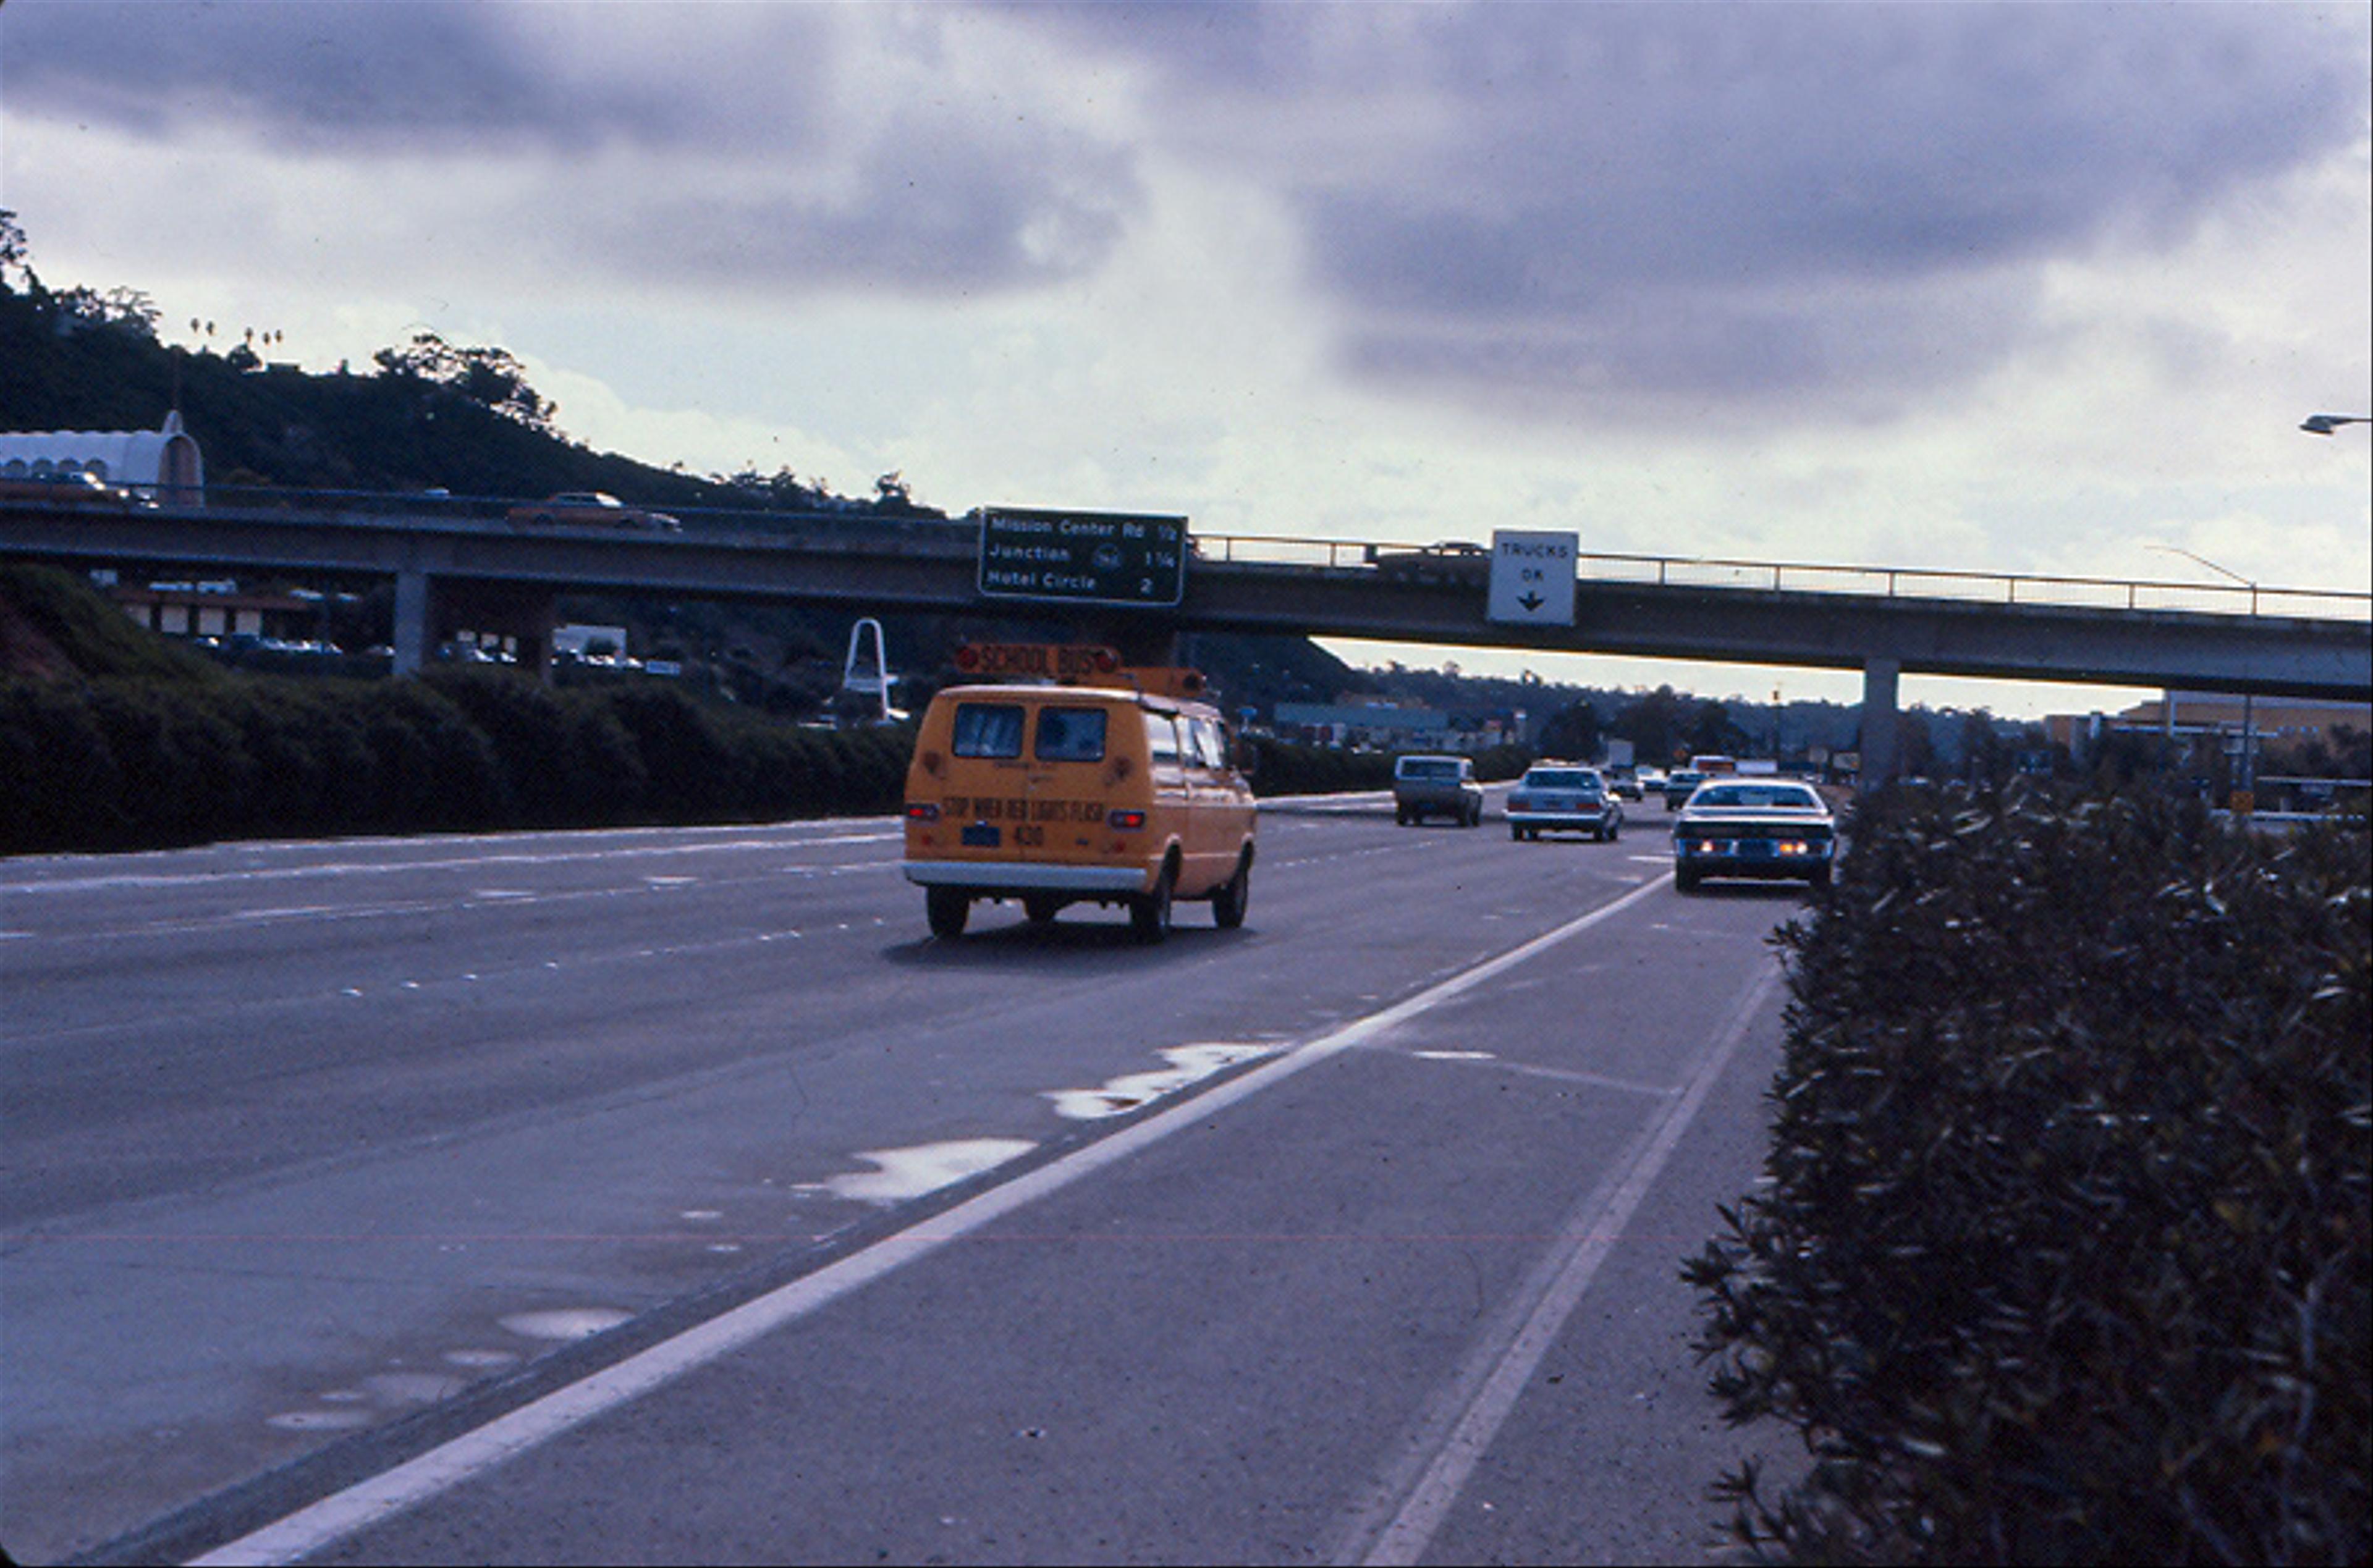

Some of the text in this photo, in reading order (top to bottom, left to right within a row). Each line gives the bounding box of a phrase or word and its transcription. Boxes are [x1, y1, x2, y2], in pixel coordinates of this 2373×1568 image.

[991, 516, 1052, 532] Mission
[1059, 519, 1115, 536] Center
[1122, 522, 1143, 538] Rd
[989, 544, 1070, 561] Junction
[1502, 543, 1568, 558] TRUCKS
[988, 572, 1153, 594] Hotel Circle 2
[1522, 568, 1543, 583] OK
[981, 646, 1094, 675] SCHOOL BUS
[943, 797, 1104, 822] STOP WHEN RED LIGHTS FLASH
